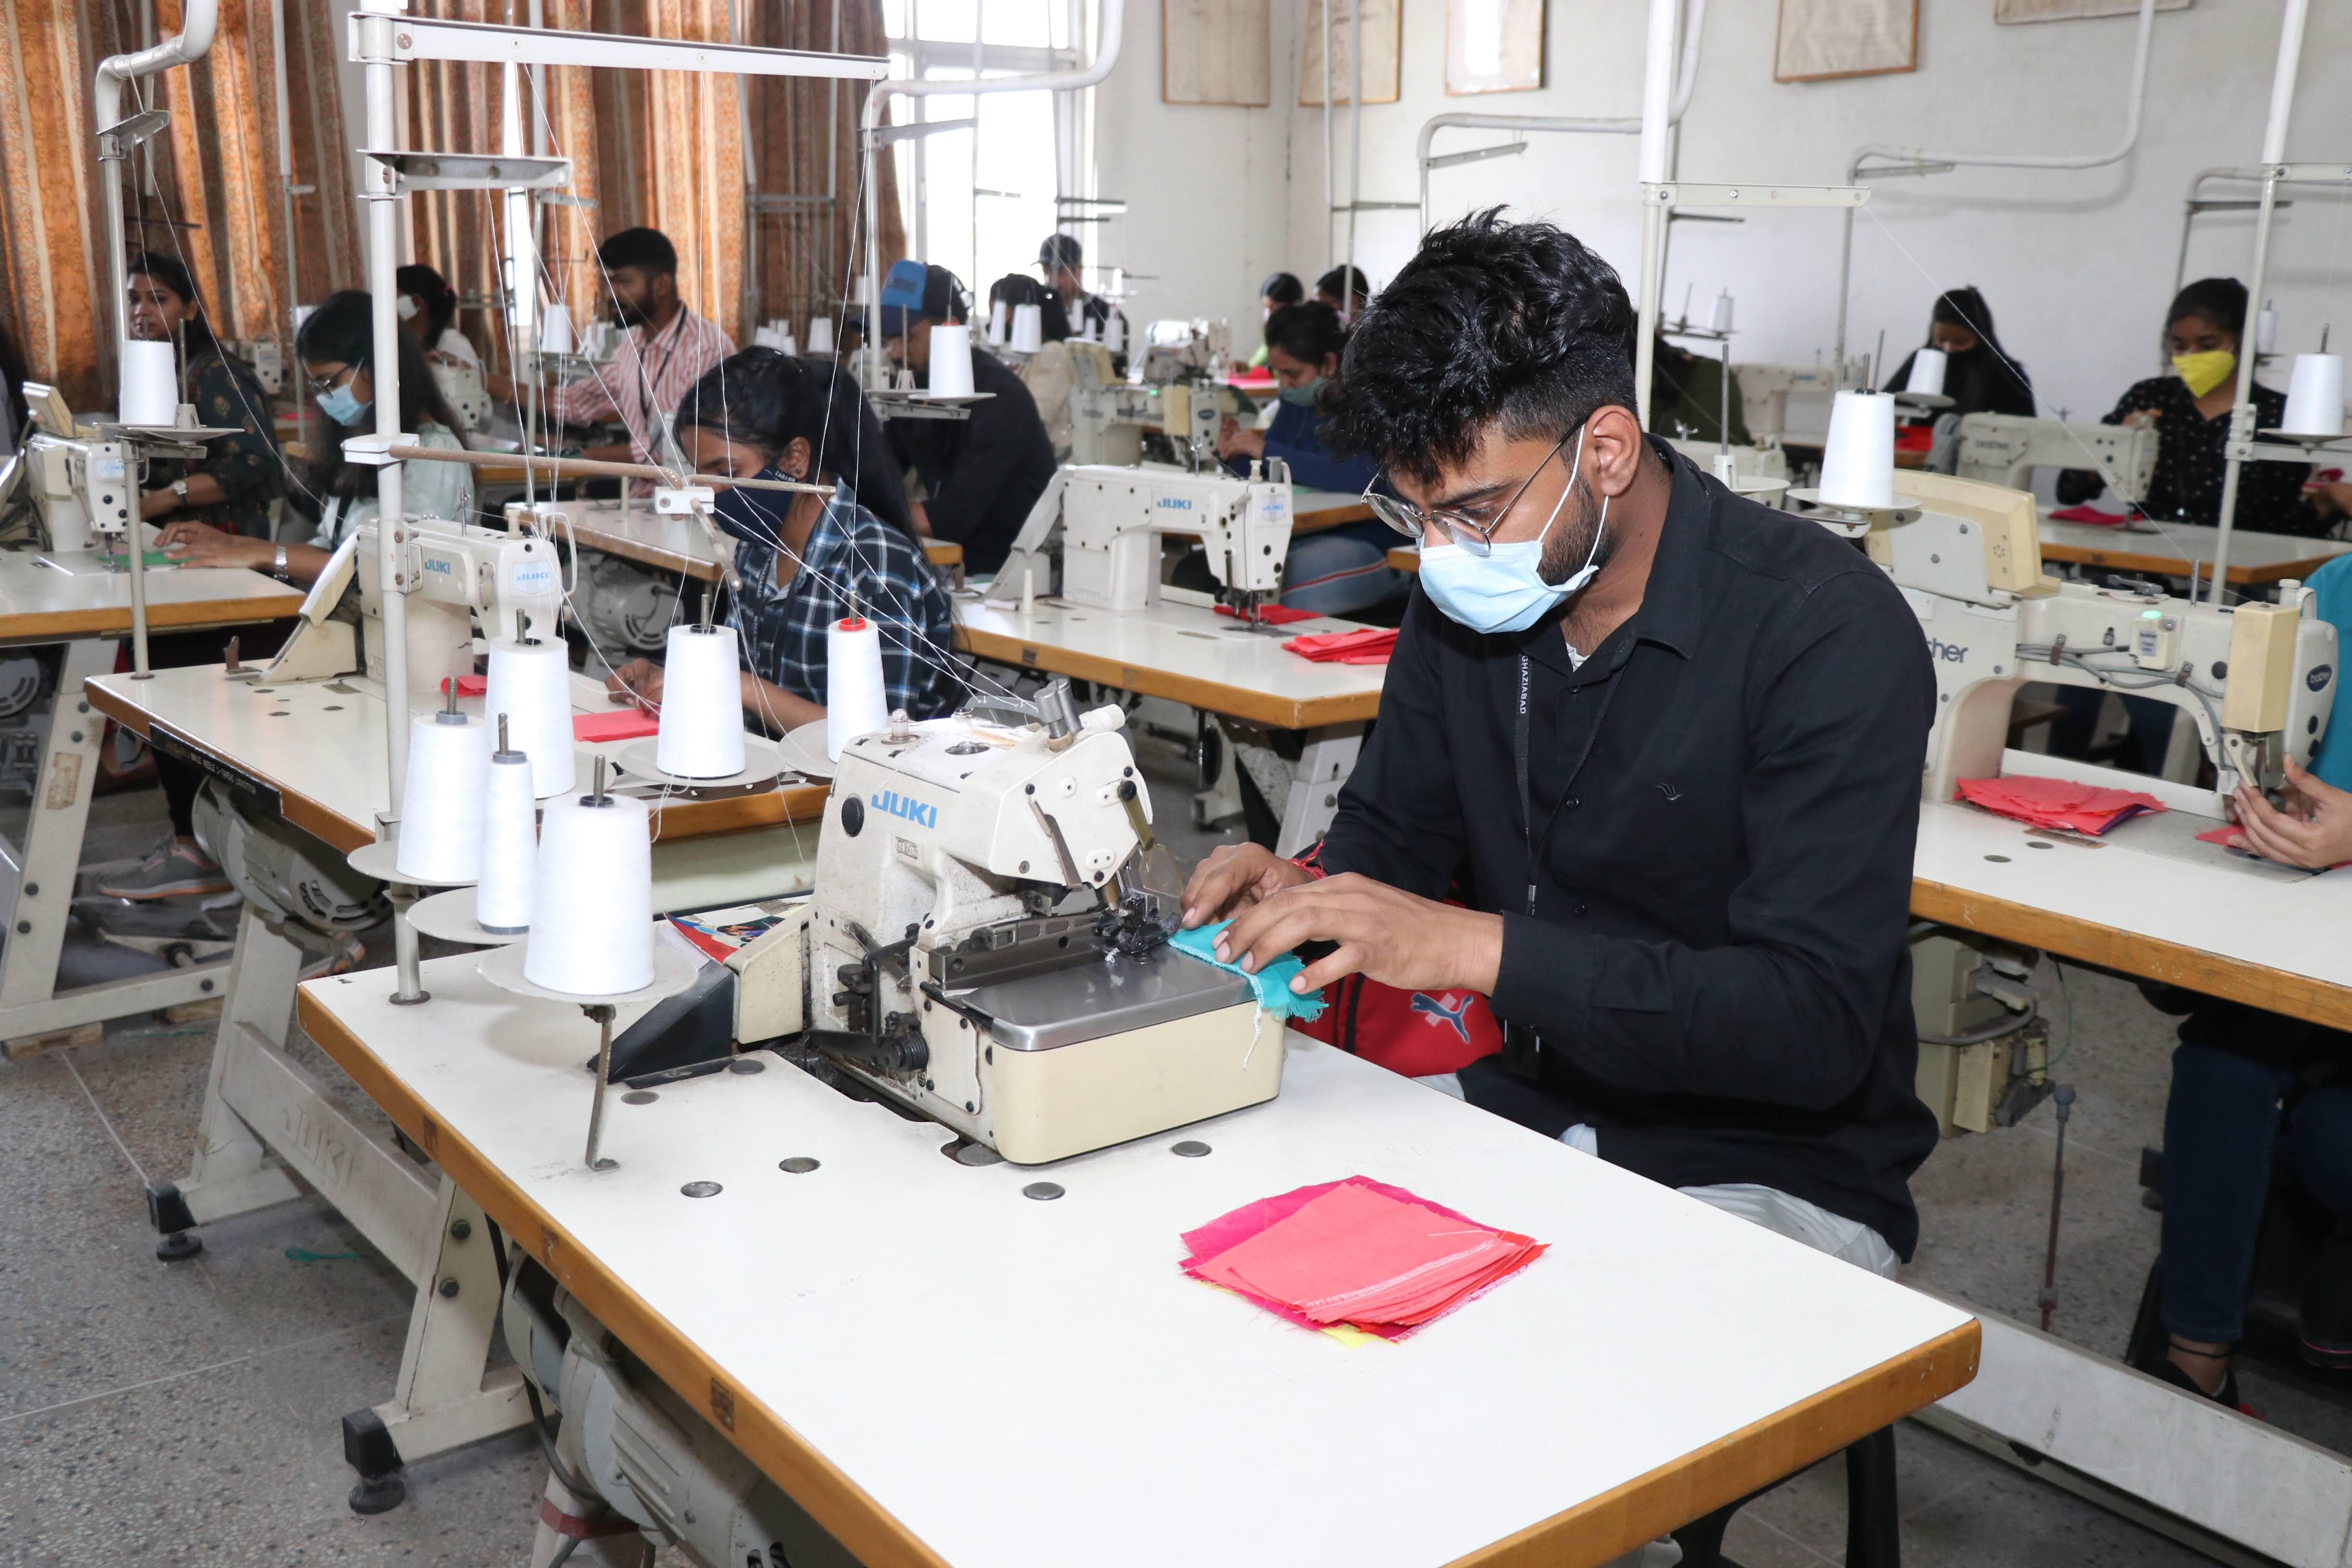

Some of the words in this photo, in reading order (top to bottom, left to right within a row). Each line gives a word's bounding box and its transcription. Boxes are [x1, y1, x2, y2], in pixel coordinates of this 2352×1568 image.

[1157, 498, 1192, 510] JUKI
[424, 559, 451, 575] JUKI
[517, 571, 549, 580] JUKI
[1520, 656, 1528, 714] GHAZIABAD
[872, 790, 937, 829] JUKI
